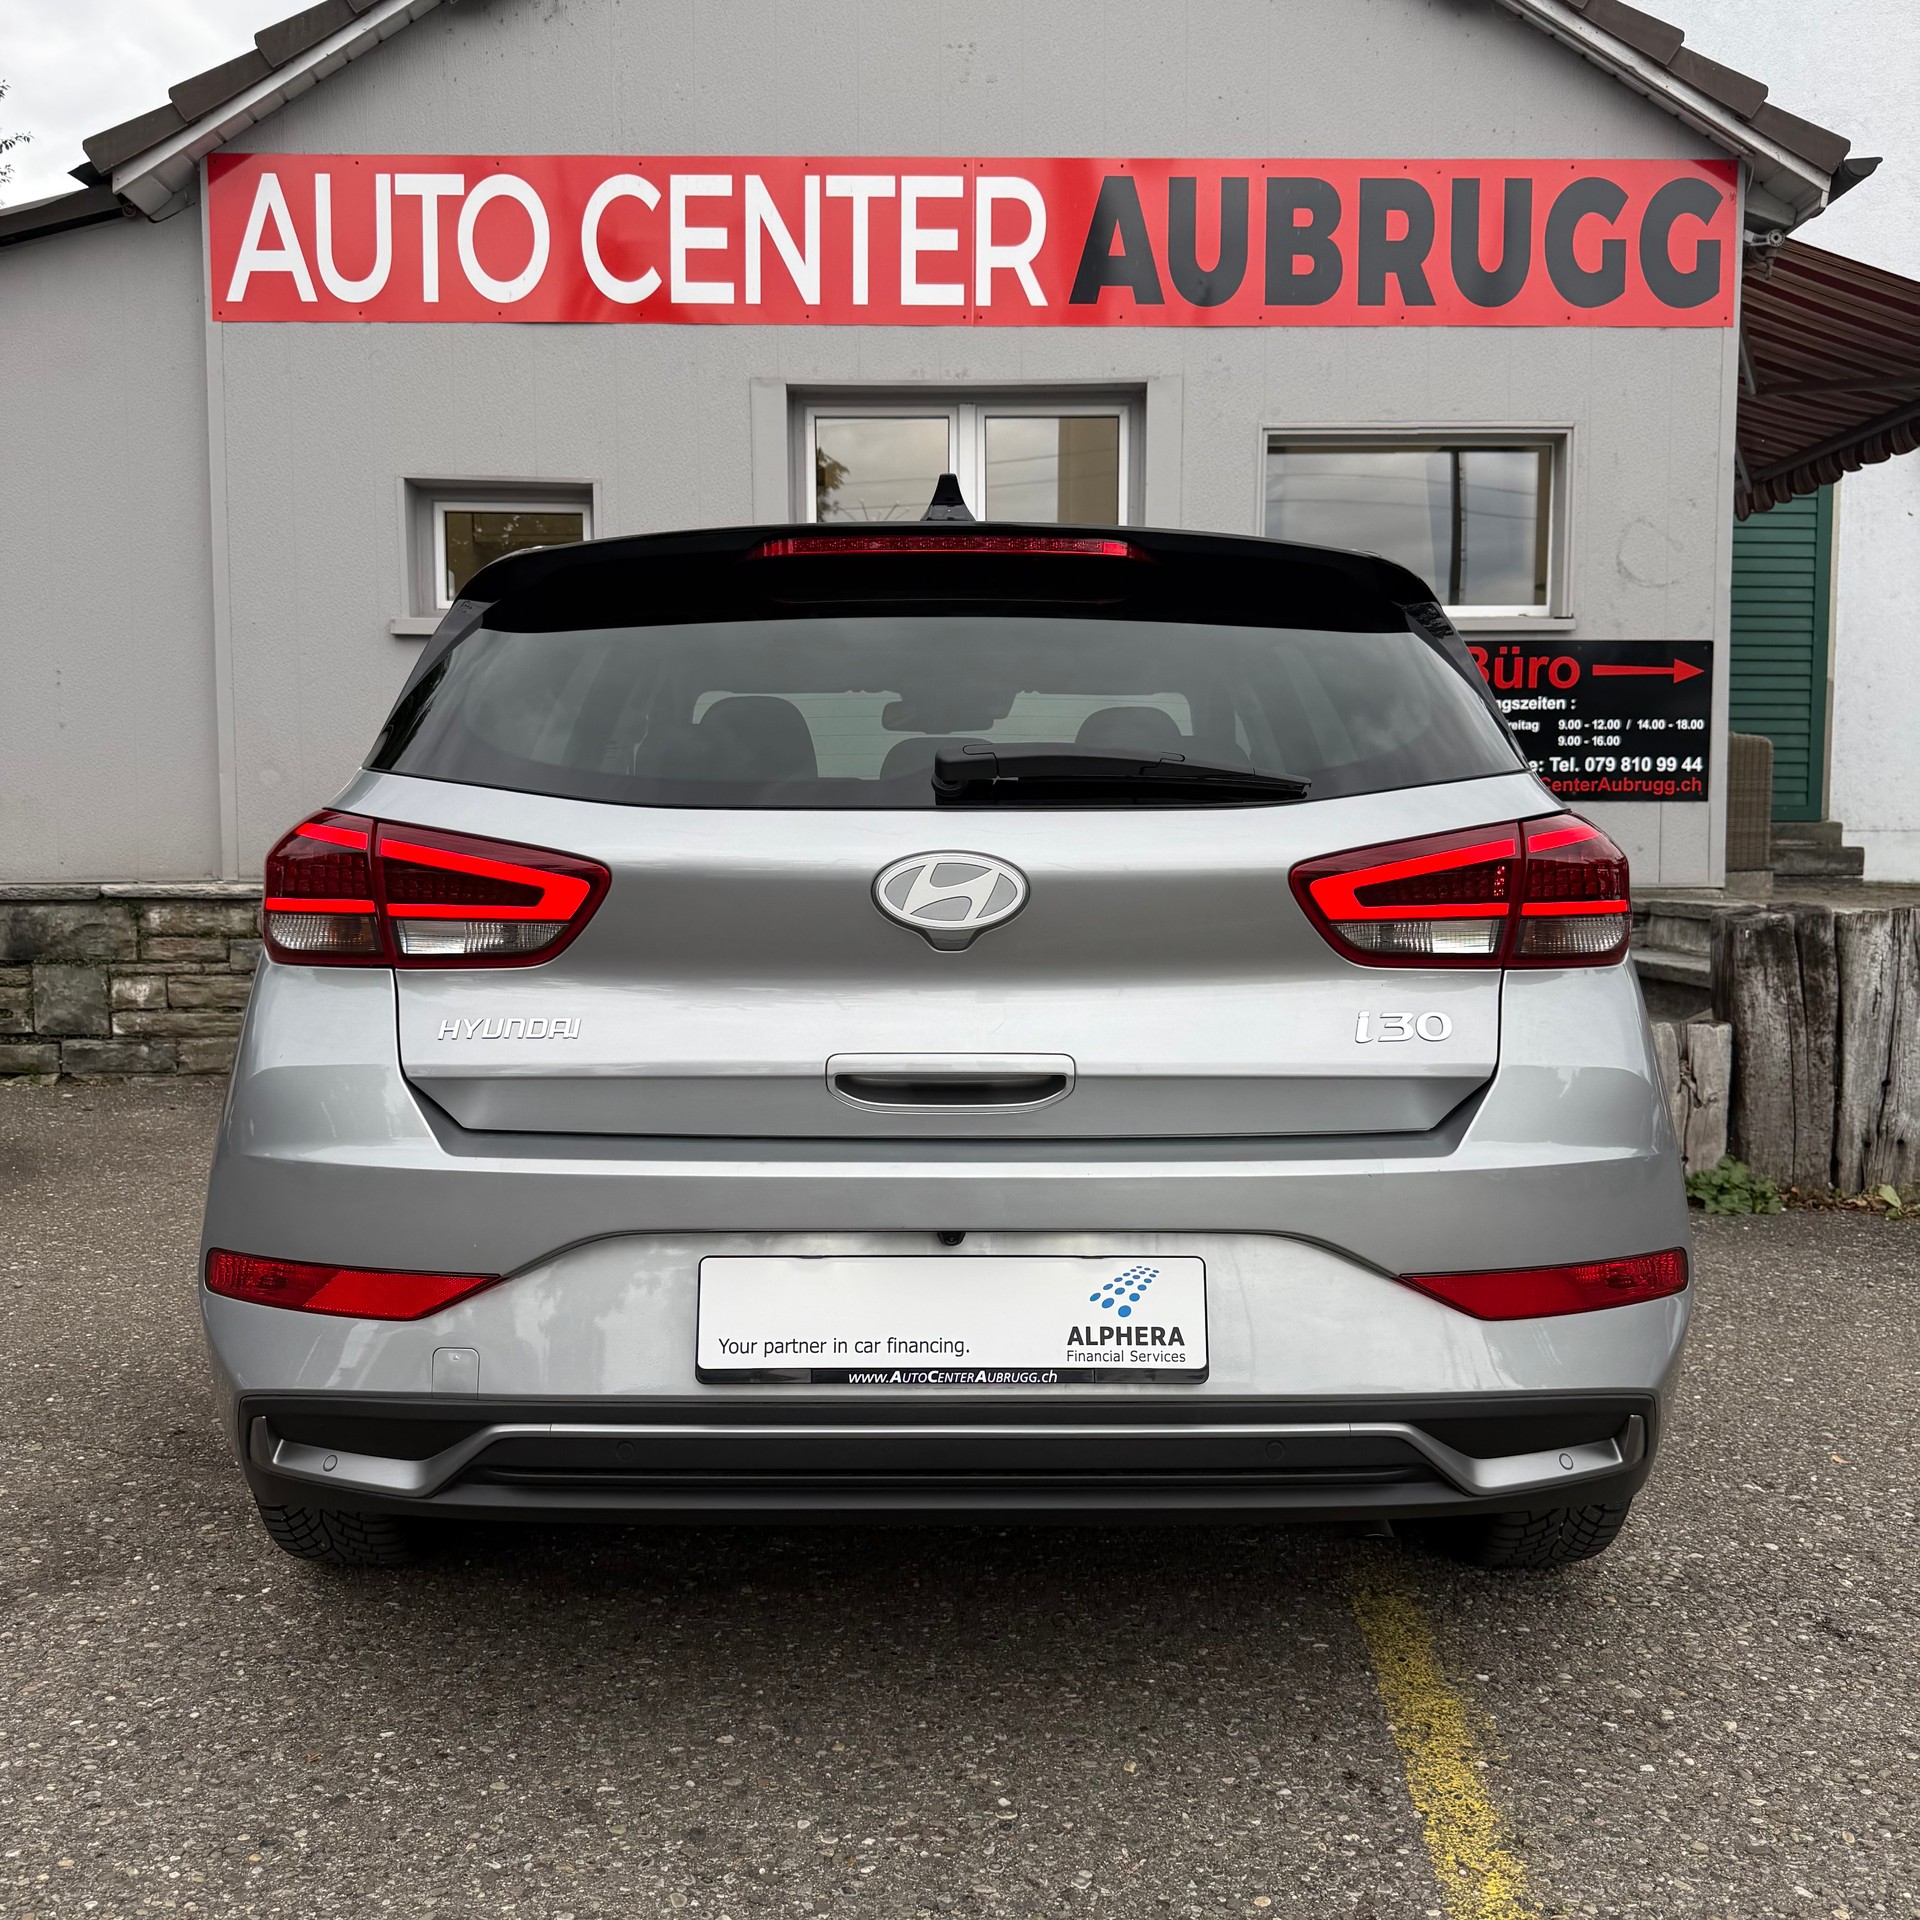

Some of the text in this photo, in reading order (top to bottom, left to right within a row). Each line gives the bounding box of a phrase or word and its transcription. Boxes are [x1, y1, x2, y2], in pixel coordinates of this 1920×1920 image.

[225, 172, 1725, 310] AUTO CENTER AUBRUGG
[1507, 719, 1540, 733] reitag
[1558, 719, 1583, 731] 9.00
[1591, 719, 1622, 731] 12.00
[1637, 719, 1667, 731] 14.00
[1676, 719, 1705, 731] 18.00
[1557, 735, 1583, 747] 9.00
[1591, 735, 1622, 747] 16.00
[1549, 756, 1581, 773] Tel.
[1584, 756, 1617, 773] 079
[1620, 756, 1652, 773] 810
[1656, 756, 1678, 773] 99
[1681, 756, 1704, 773] 44
[437, 1017, 582, 1040] HYUNDAI
[1354, 1010, 1453, 1044] i30
[1066, 1326, 1186, 1346] ALPHERA
[718, 1336, 970, 1358] Your partner in car financing.
[1066, 1350, 1186, 1363] Financial Services
